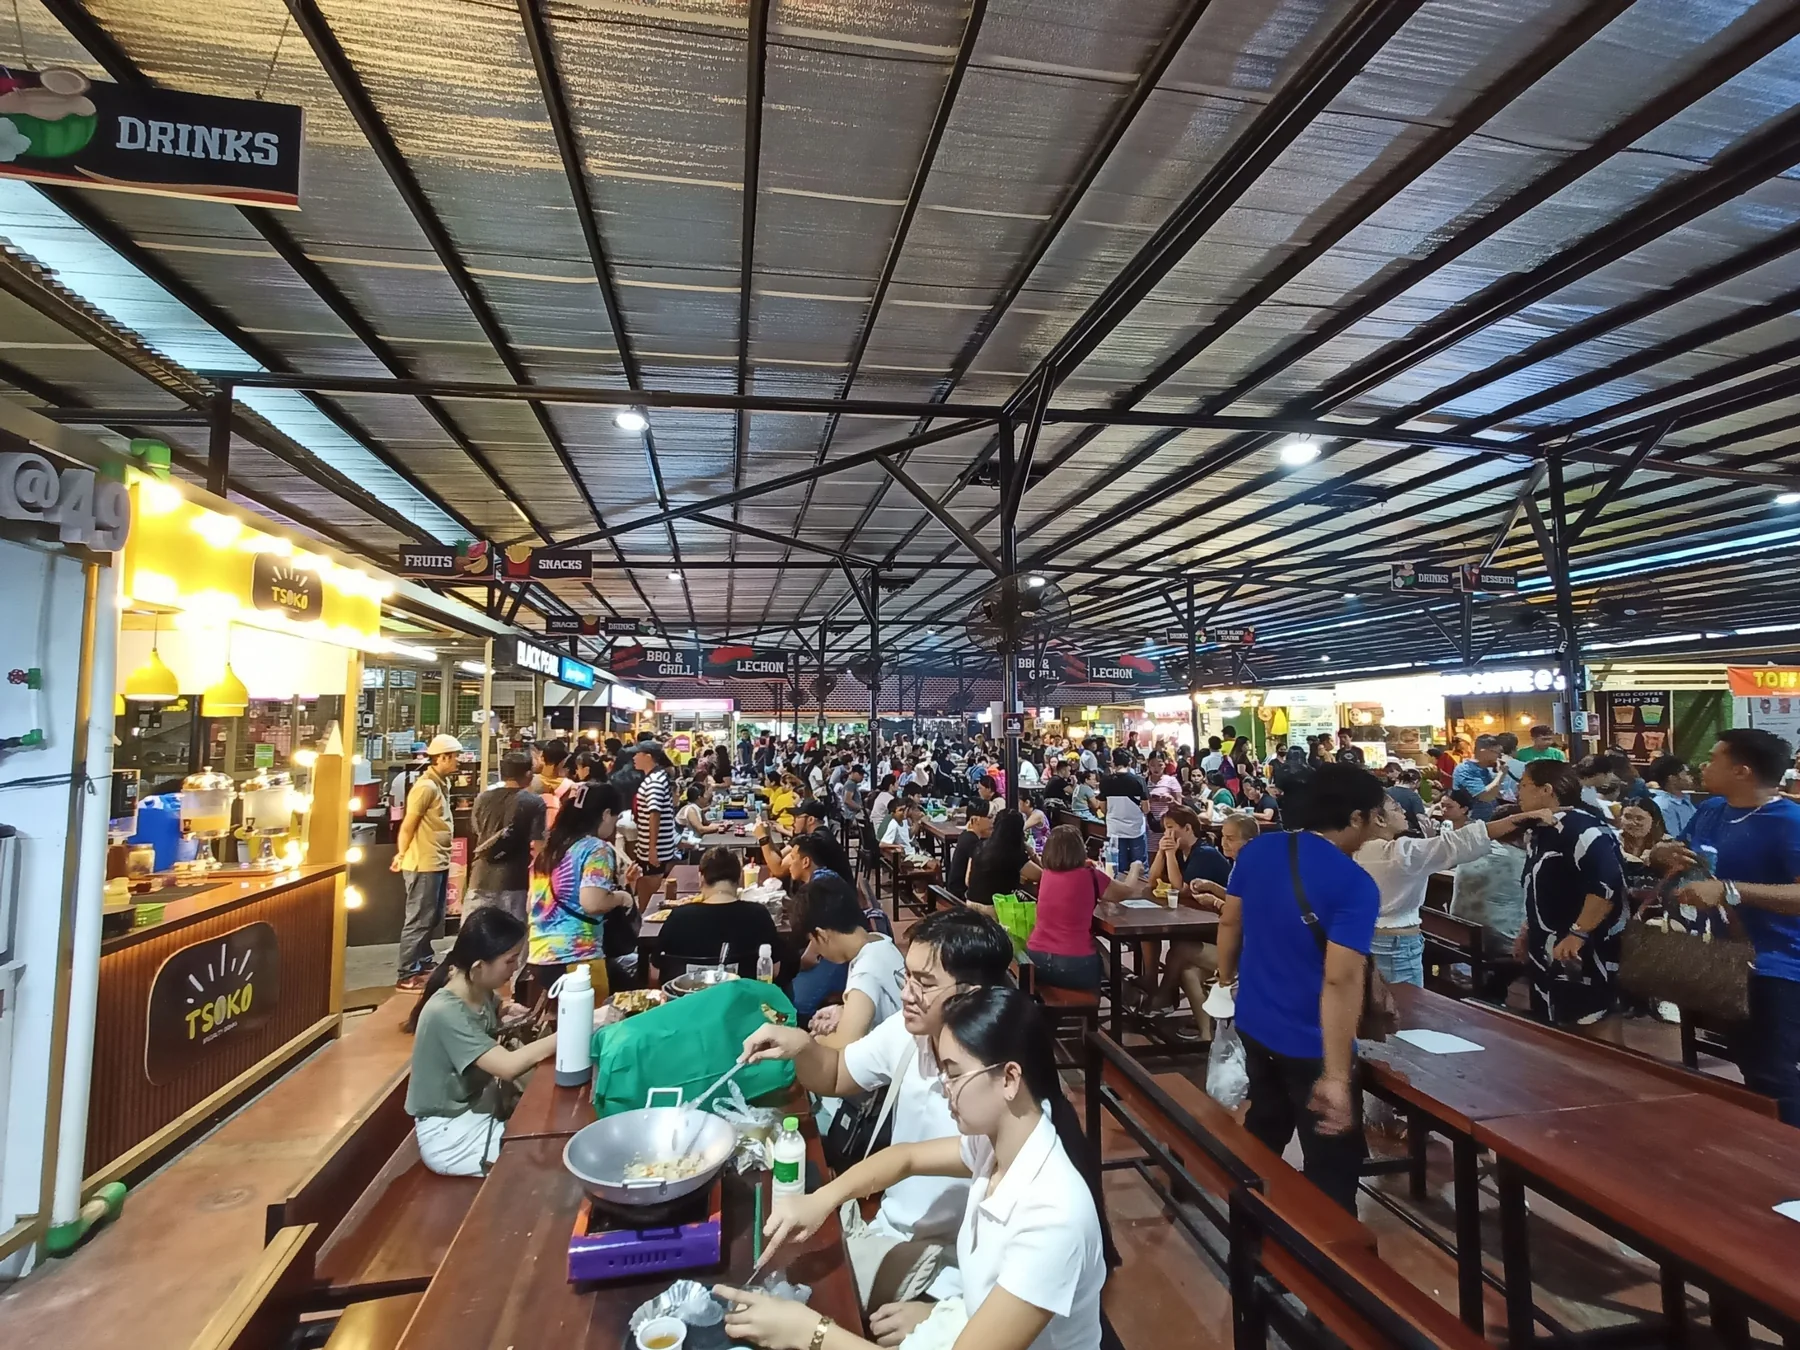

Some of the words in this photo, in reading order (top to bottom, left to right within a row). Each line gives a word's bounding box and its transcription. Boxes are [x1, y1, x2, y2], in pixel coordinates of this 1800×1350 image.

[116, 115, 279, 166] DRINKS
[404, 554, 453, 568] FRUITS
[538, 559, 583, 571] SNACKS
[1418, 573, 1449, 584] DRINKS
[1481, 574, 1515, 584] DESSERTS
[552, 621, 579, 629] SNACKS
[608, 622, 636, 631] DRINKS
[646, 650, 671, 663] BBQ
[675, 651, 683, 663] &
[658, 664, 695, 676] GRILL
[737, 660, 784, 673] LECHON
[1042, 659, 1050, 669] &
[1092, 668, 1132, 679] LECHON
[1753, 671, 1800, 689] TOFF
